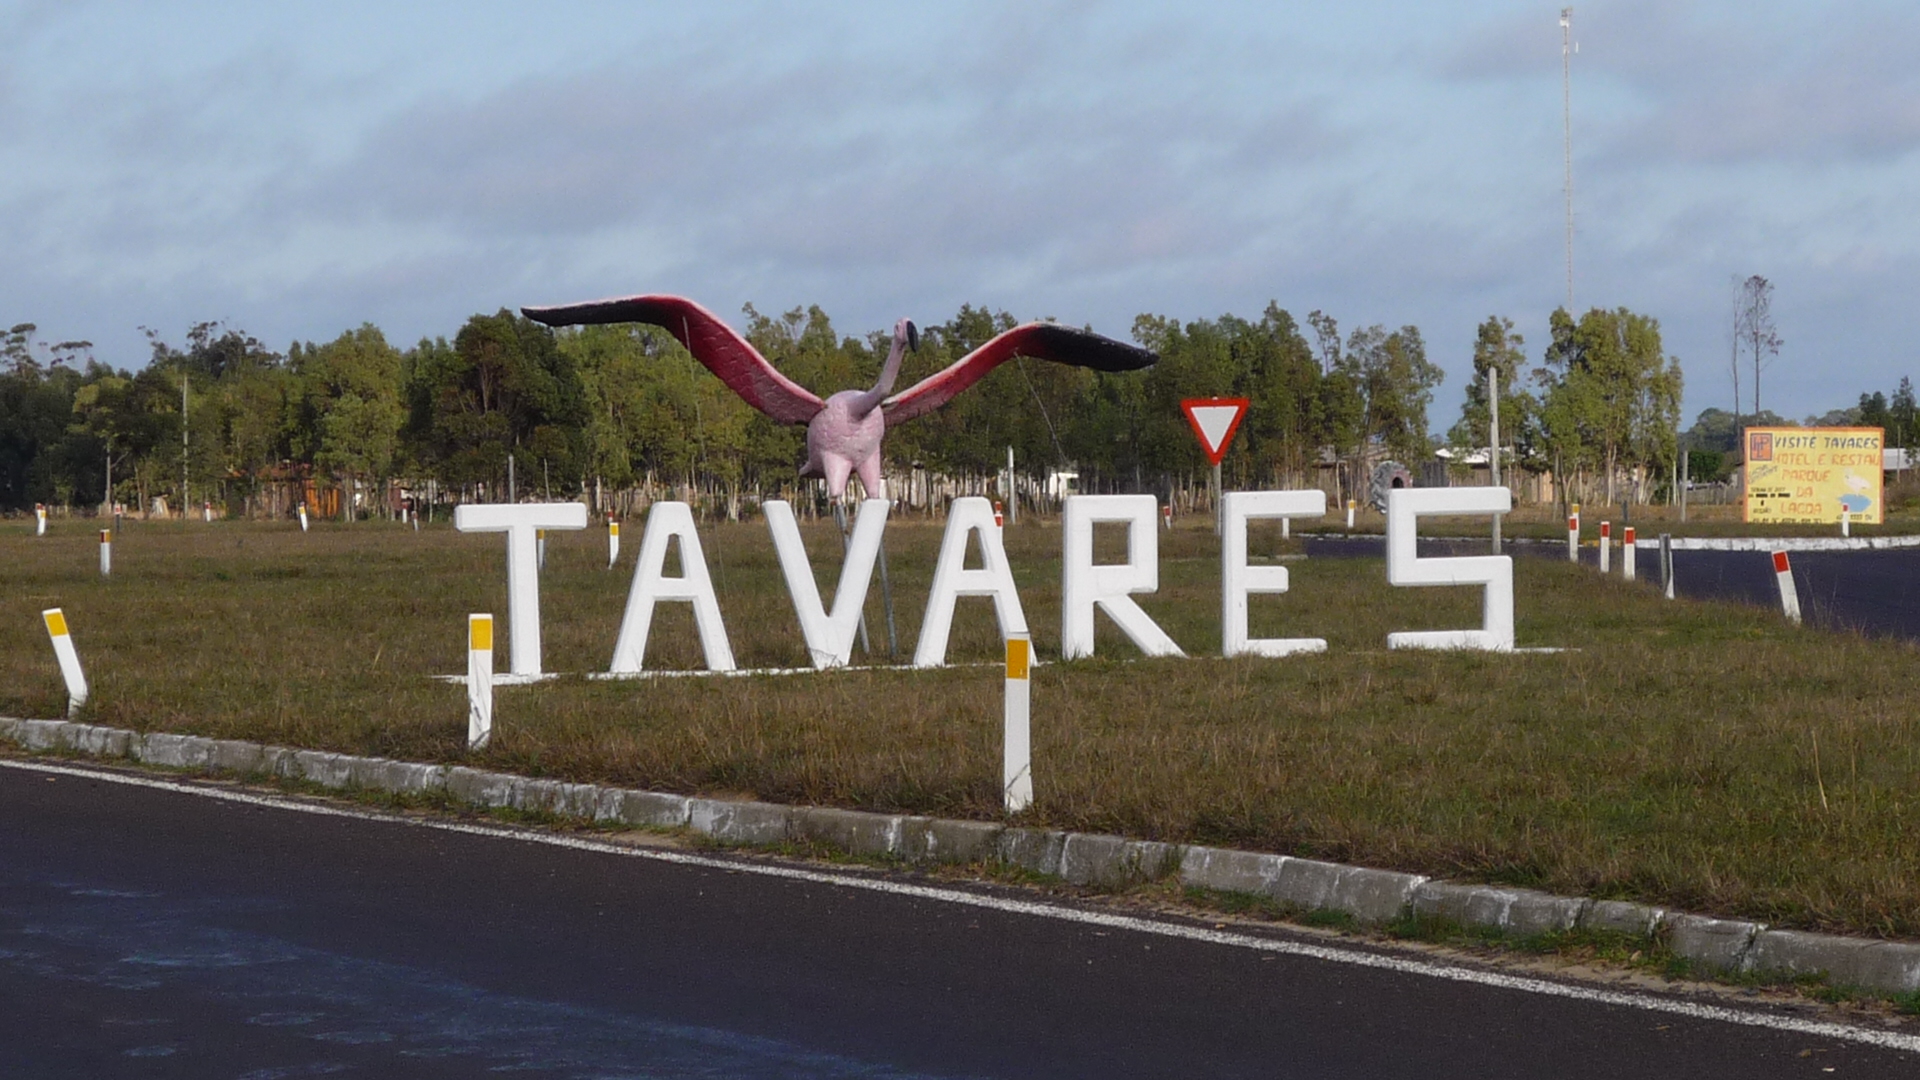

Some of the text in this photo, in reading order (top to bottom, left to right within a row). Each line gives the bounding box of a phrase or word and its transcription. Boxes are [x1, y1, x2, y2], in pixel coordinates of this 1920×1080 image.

[1774, 436, 1879, 449] VISITE TAVARES
[1774, 453, 1811, 465] HOTEL
[1818, 454, 1826, 464] E
[1781, 468, 1831, 482] PARQUE
[1796, 486, 1814, 498] DA
[456, 486, 1515, 676] TAVARES
